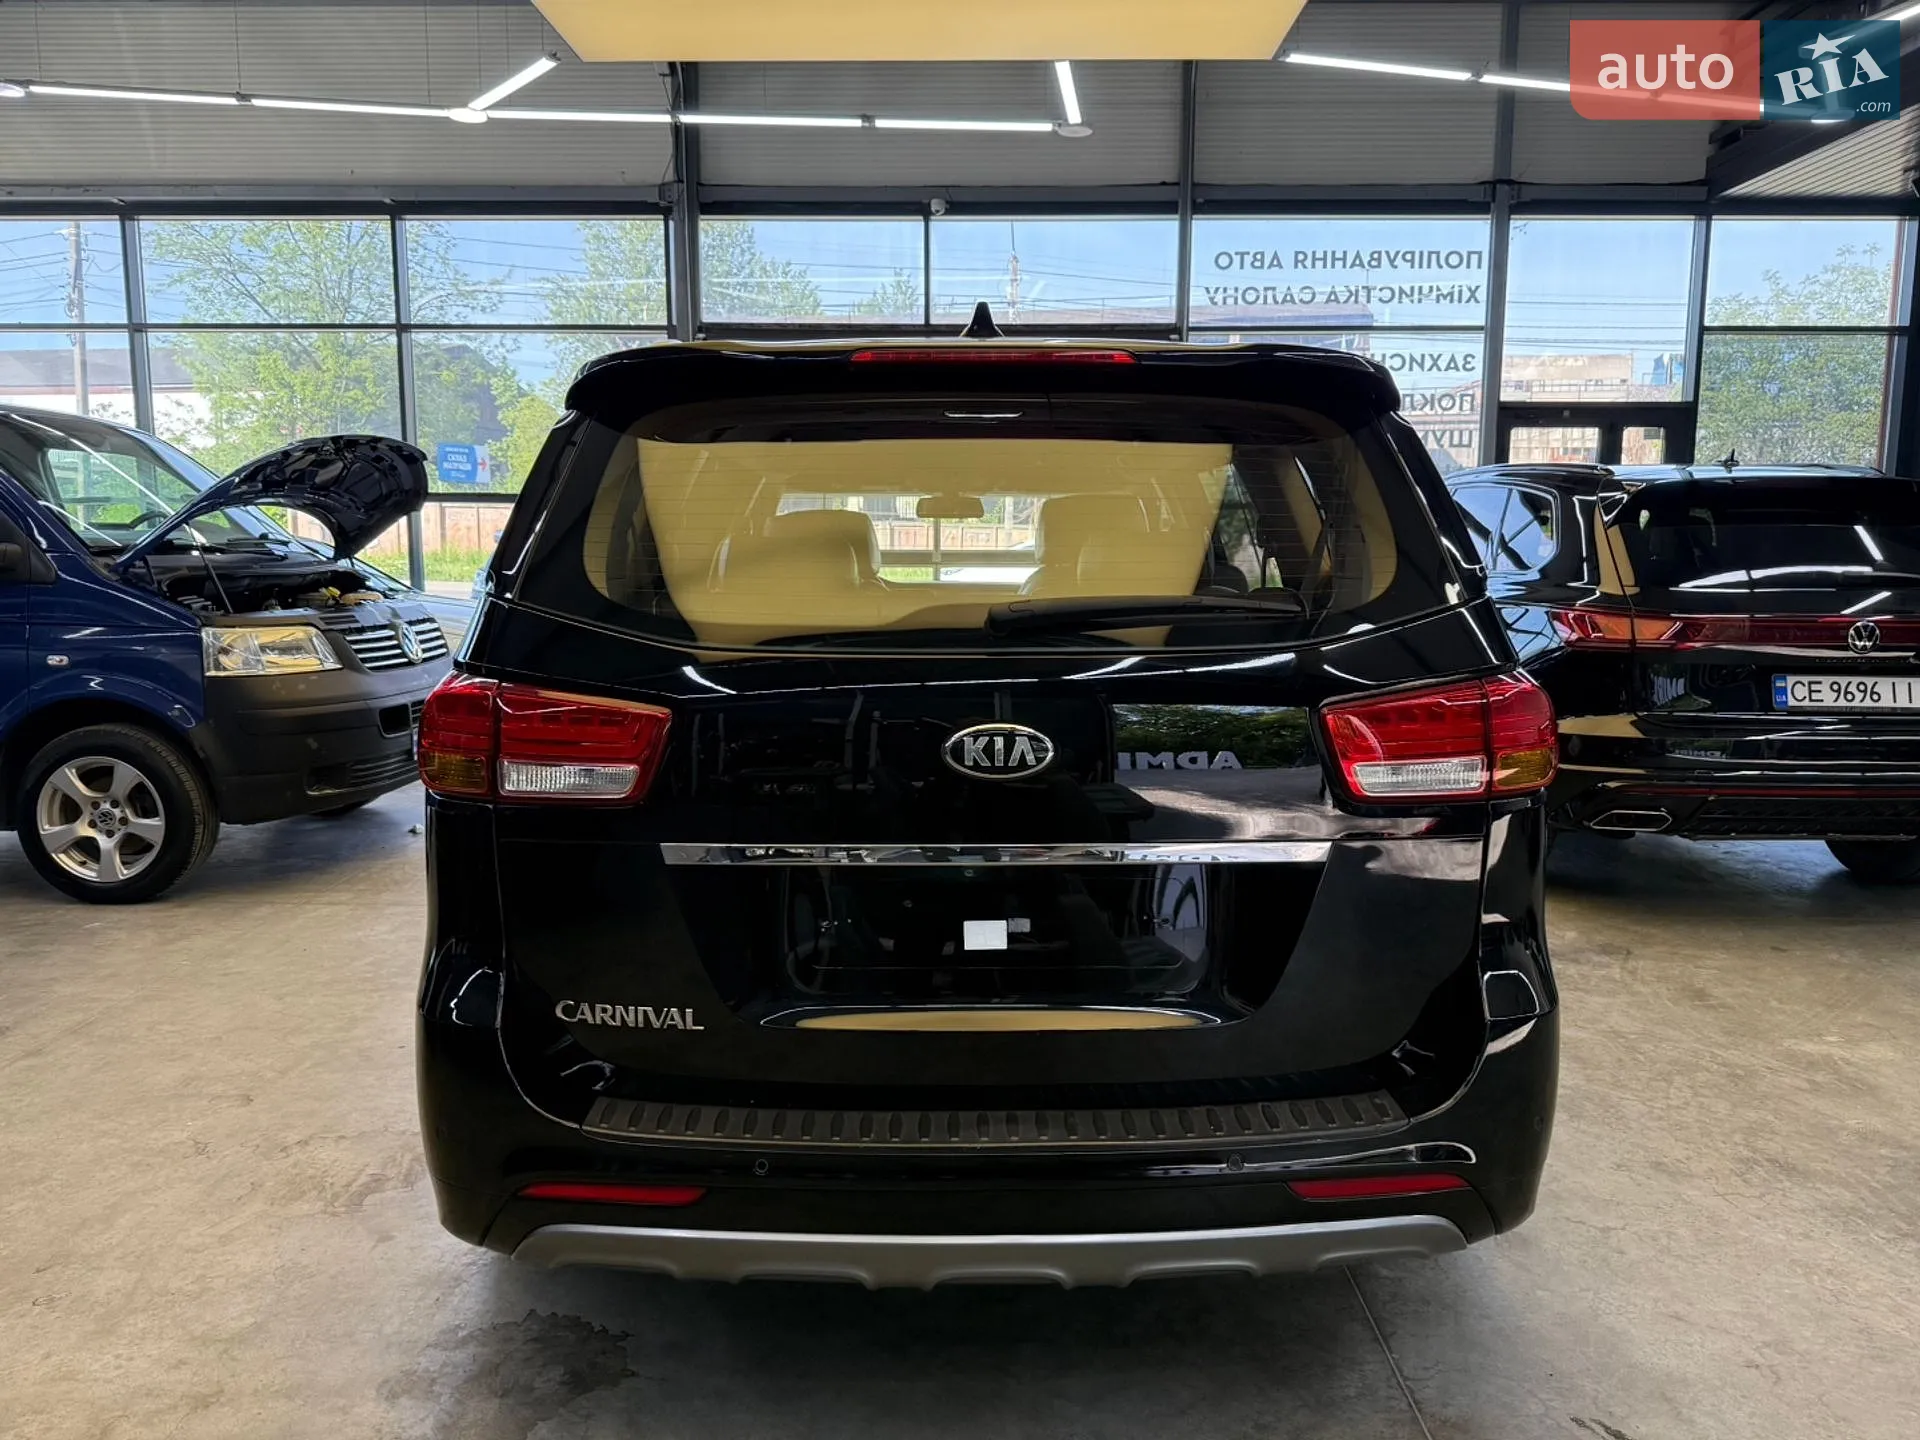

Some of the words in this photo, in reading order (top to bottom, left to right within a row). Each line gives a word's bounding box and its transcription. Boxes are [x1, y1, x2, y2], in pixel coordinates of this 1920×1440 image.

[1790, 680, 1824, 703] CE
[1829, 680, 1881, 703] 9696
[963, 735, 1038, 767] KIA
[554, 999, 705, 1031] CARNIVAL
